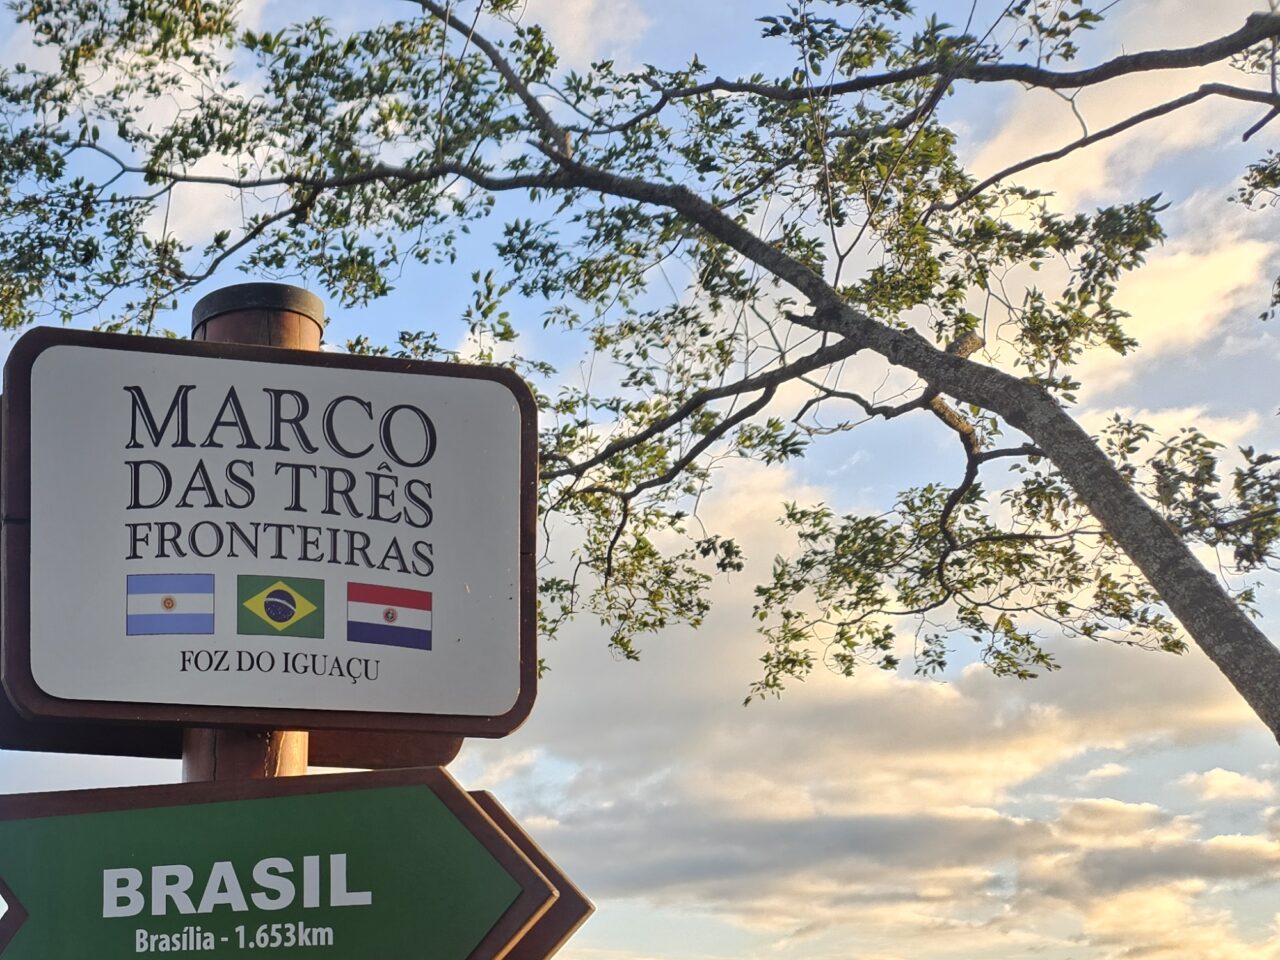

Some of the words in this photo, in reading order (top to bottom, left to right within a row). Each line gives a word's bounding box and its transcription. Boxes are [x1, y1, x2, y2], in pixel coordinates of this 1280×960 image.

[124, 385, 438, 468] MARCO
[125, 459, 256, 510] DAS
[275, 462, 433, 529] TRÊS
[125, 521, 435, 577] FRONTEIRAS
[180, 650, 231, 673] FOZ
[236, 651, 275, 673] DO
[282, 652, 380, 684] IGUAÇU
[103, 853, 372, 918] BRASIL
[135, 926, 215, 952] Brasília
[235, 921, 334, 949] 1.653km
